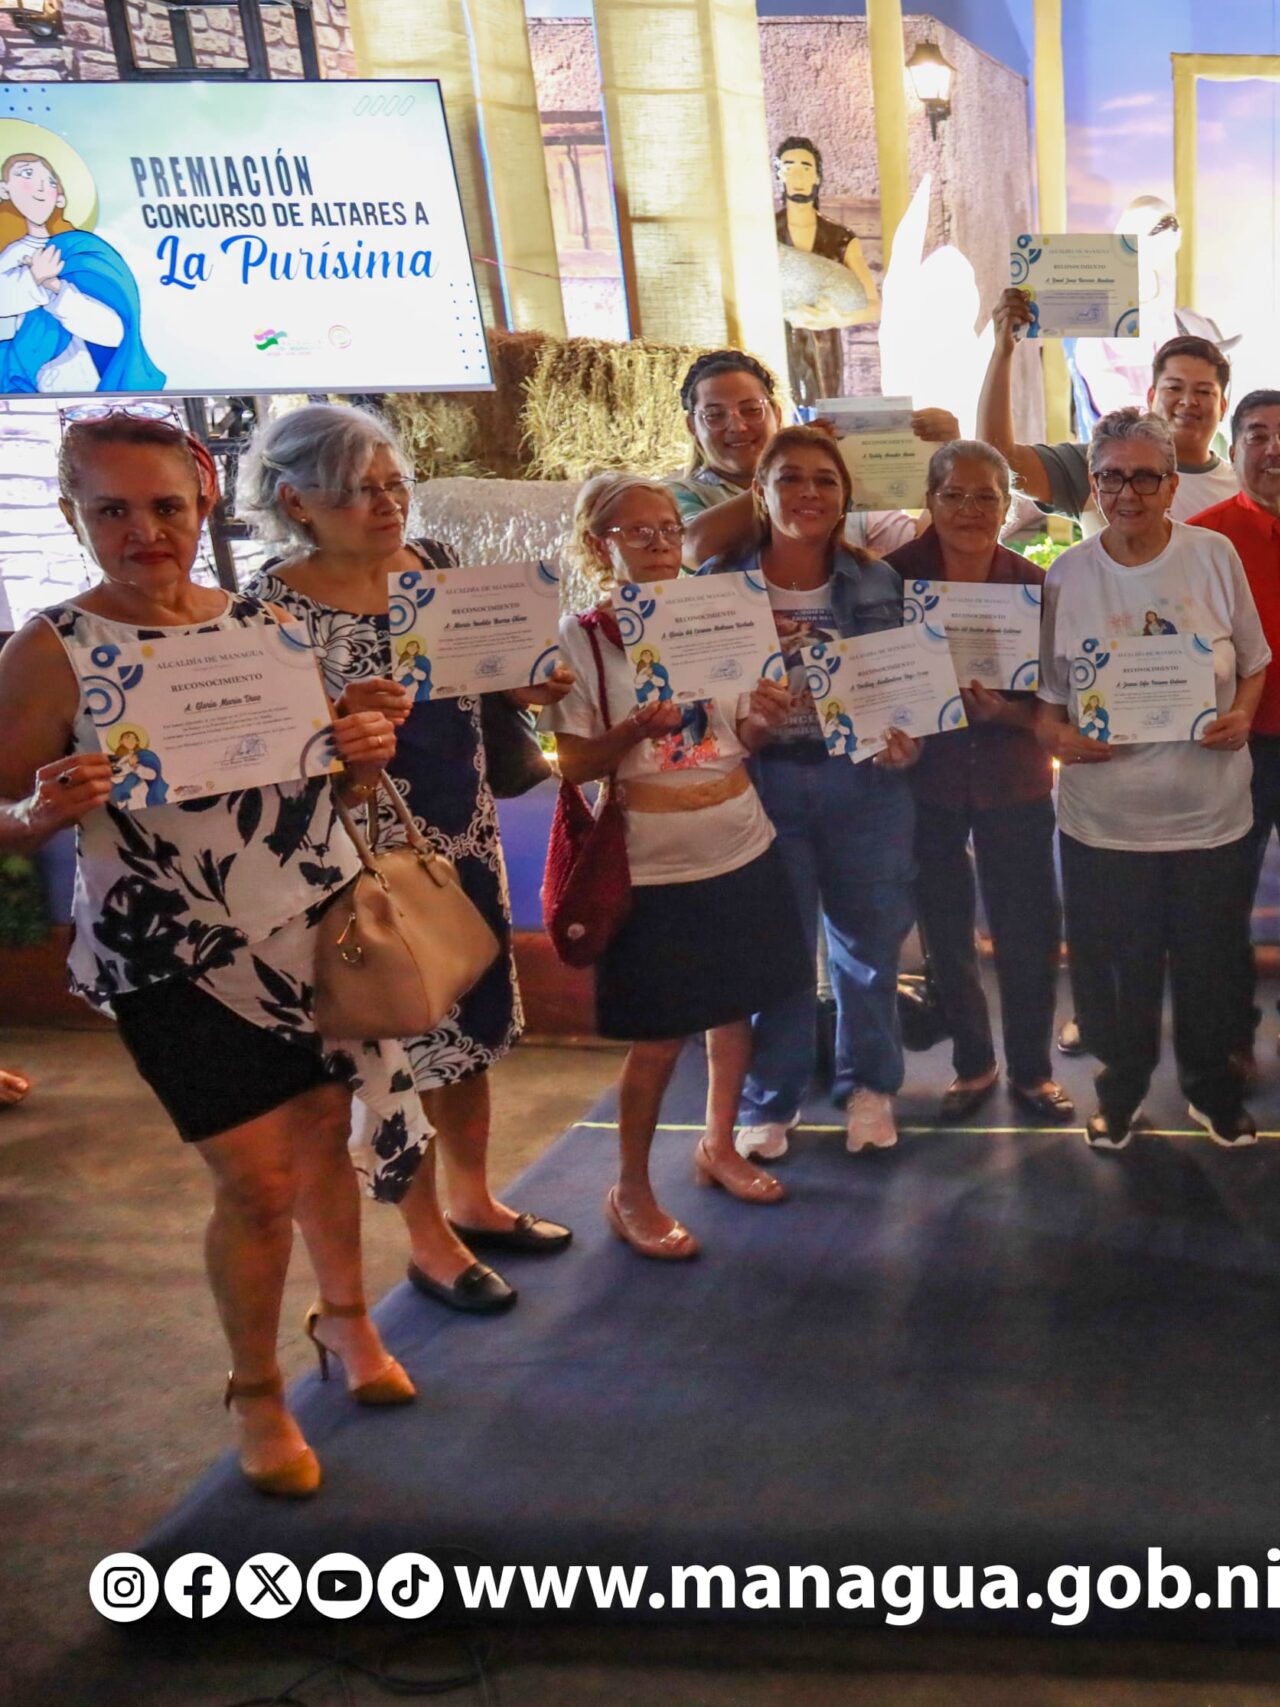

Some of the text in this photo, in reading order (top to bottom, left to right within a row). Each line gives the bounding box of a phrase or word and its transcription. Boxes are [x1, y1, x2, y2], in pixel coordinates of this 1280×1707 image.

[130, 148, 313, 197] PREMIACIÓN
[142, 202, 429, 229] CONCURSO DE ALTARES A
[156, 234, 439, 290] La Purísima
[451, 602, 520, 614] RECONOCIMIENTO
[157, 650, 264, 671] ALCALDÍA DE MANAGUA
[170, 672, 263, 693] RECONOCIMIENTO
